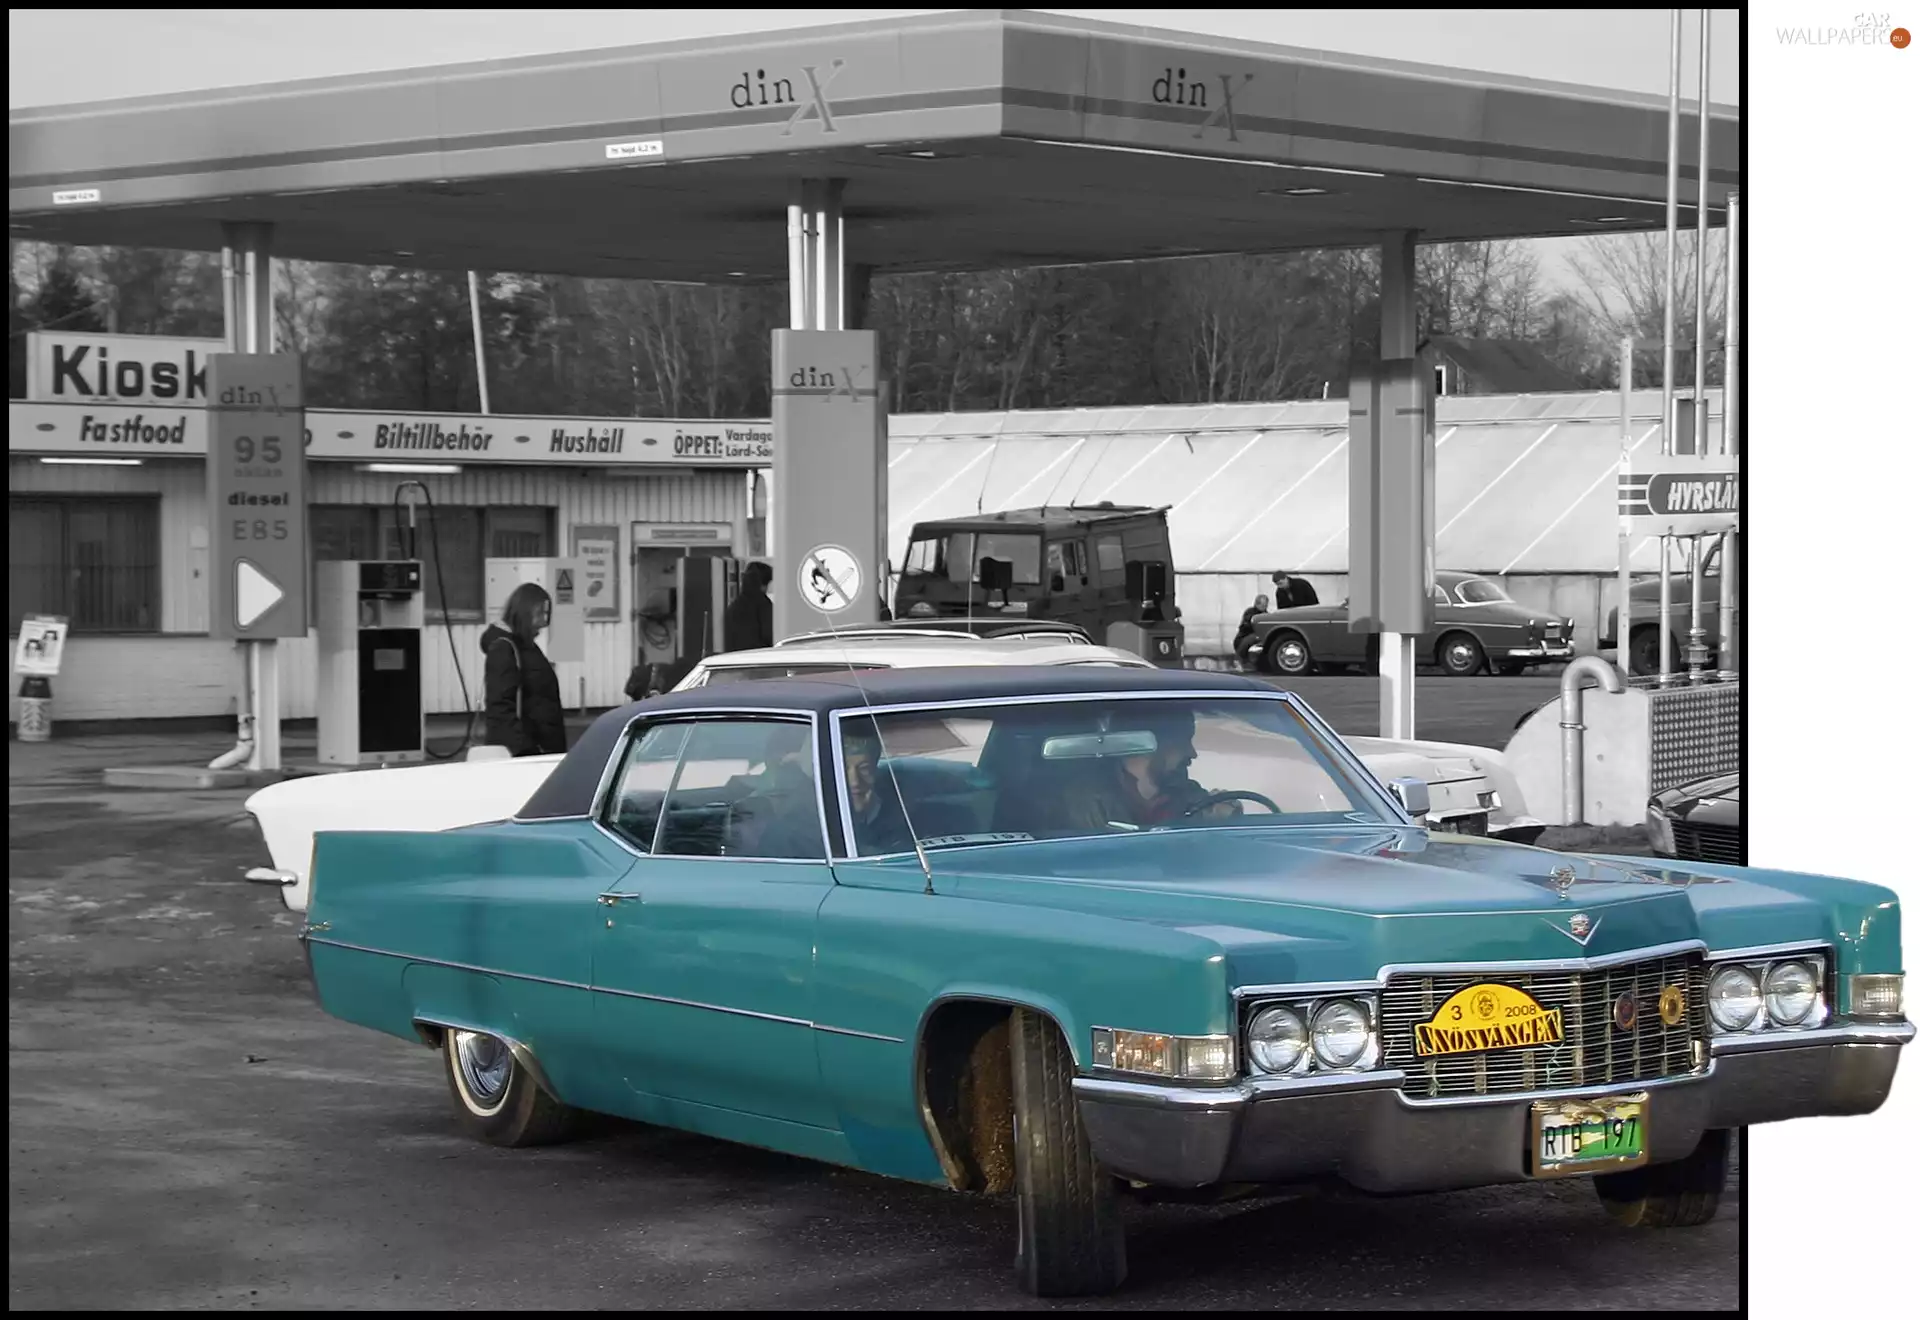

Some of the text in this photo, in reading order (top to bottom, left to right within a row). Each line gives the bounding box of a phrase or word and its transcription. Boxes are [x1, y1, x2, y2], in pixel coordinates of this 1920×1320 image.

[53, 344, 207, 398] Kiosk
[79, 414, 723, 457] Fastfood Biltillbehör Hushåll ÖPPET:
[234, 435, 282, 463] 95
[227, 491, 289, 506] diesel
[233, 519, 288, 540] E85
[1451, 1004, 1537, 1021] 3 2008
[1543, 1117, 1638, 1156] RTB 197
